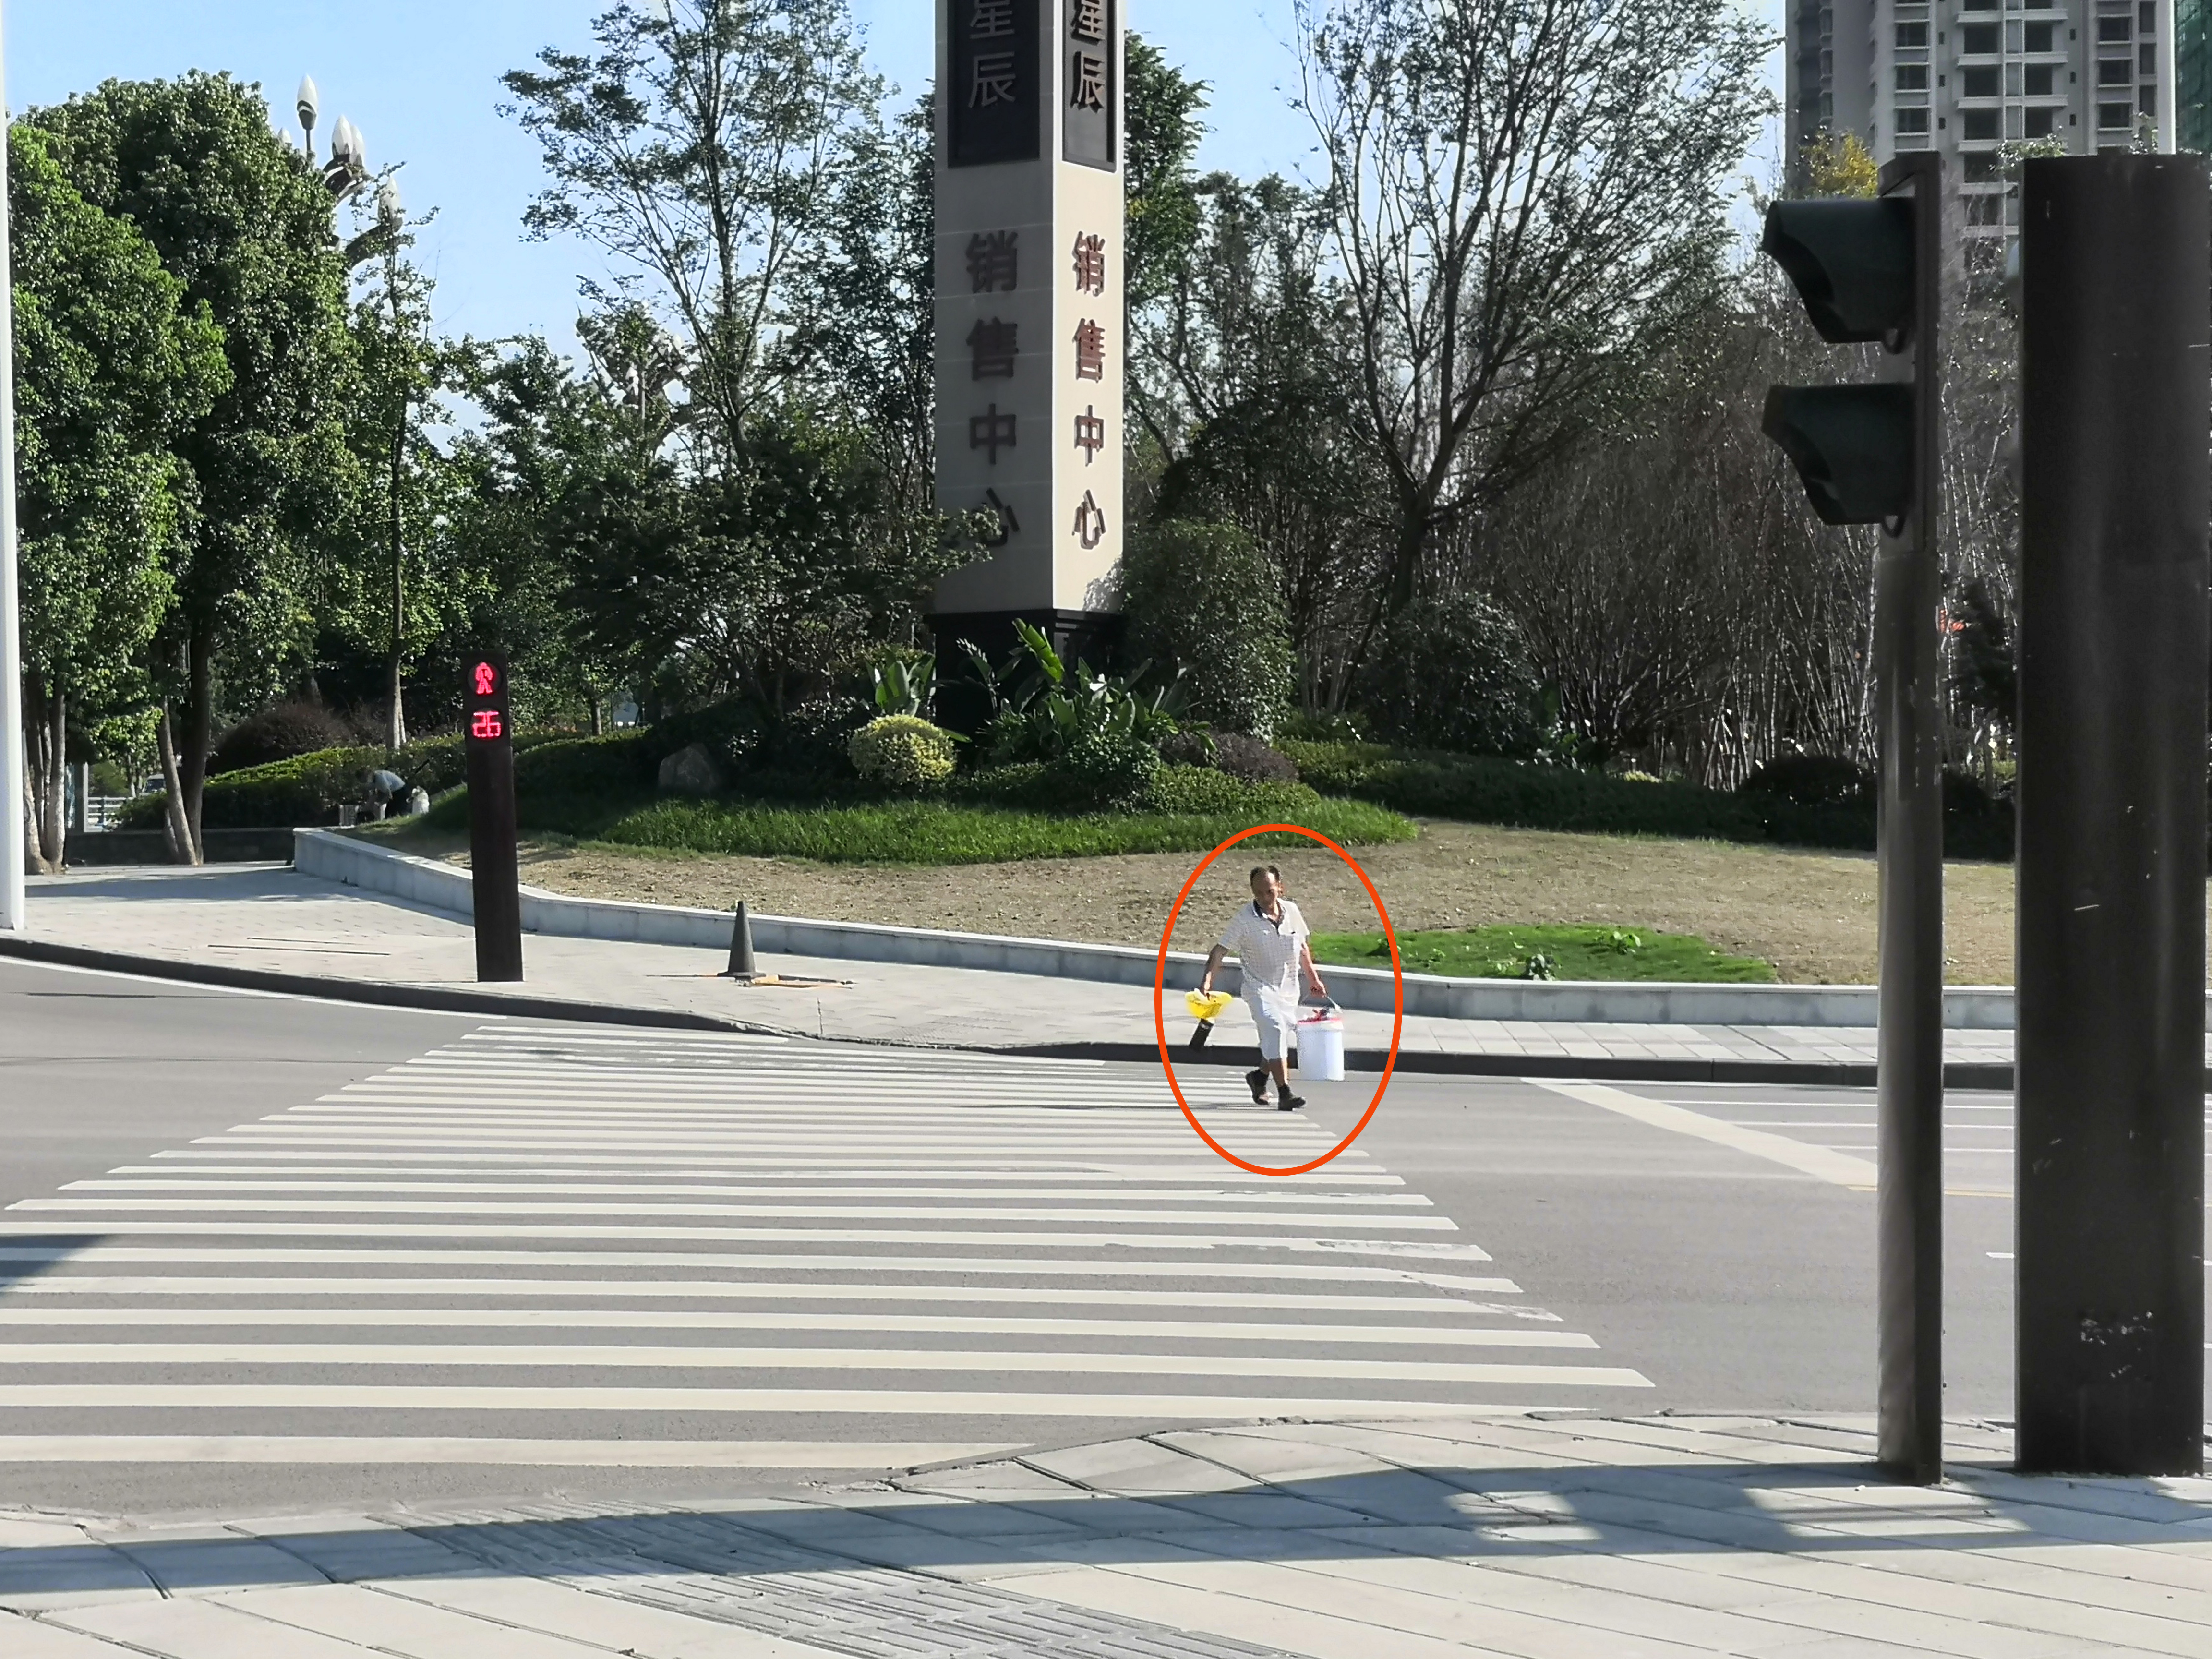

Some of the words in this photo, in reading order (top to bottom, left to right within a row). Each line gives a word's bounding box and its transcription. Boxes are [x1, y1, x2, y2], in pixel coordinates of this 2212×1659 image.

[1072, 230, 1106, 550] 销售中心
[472, 711, 501, 737] 26
